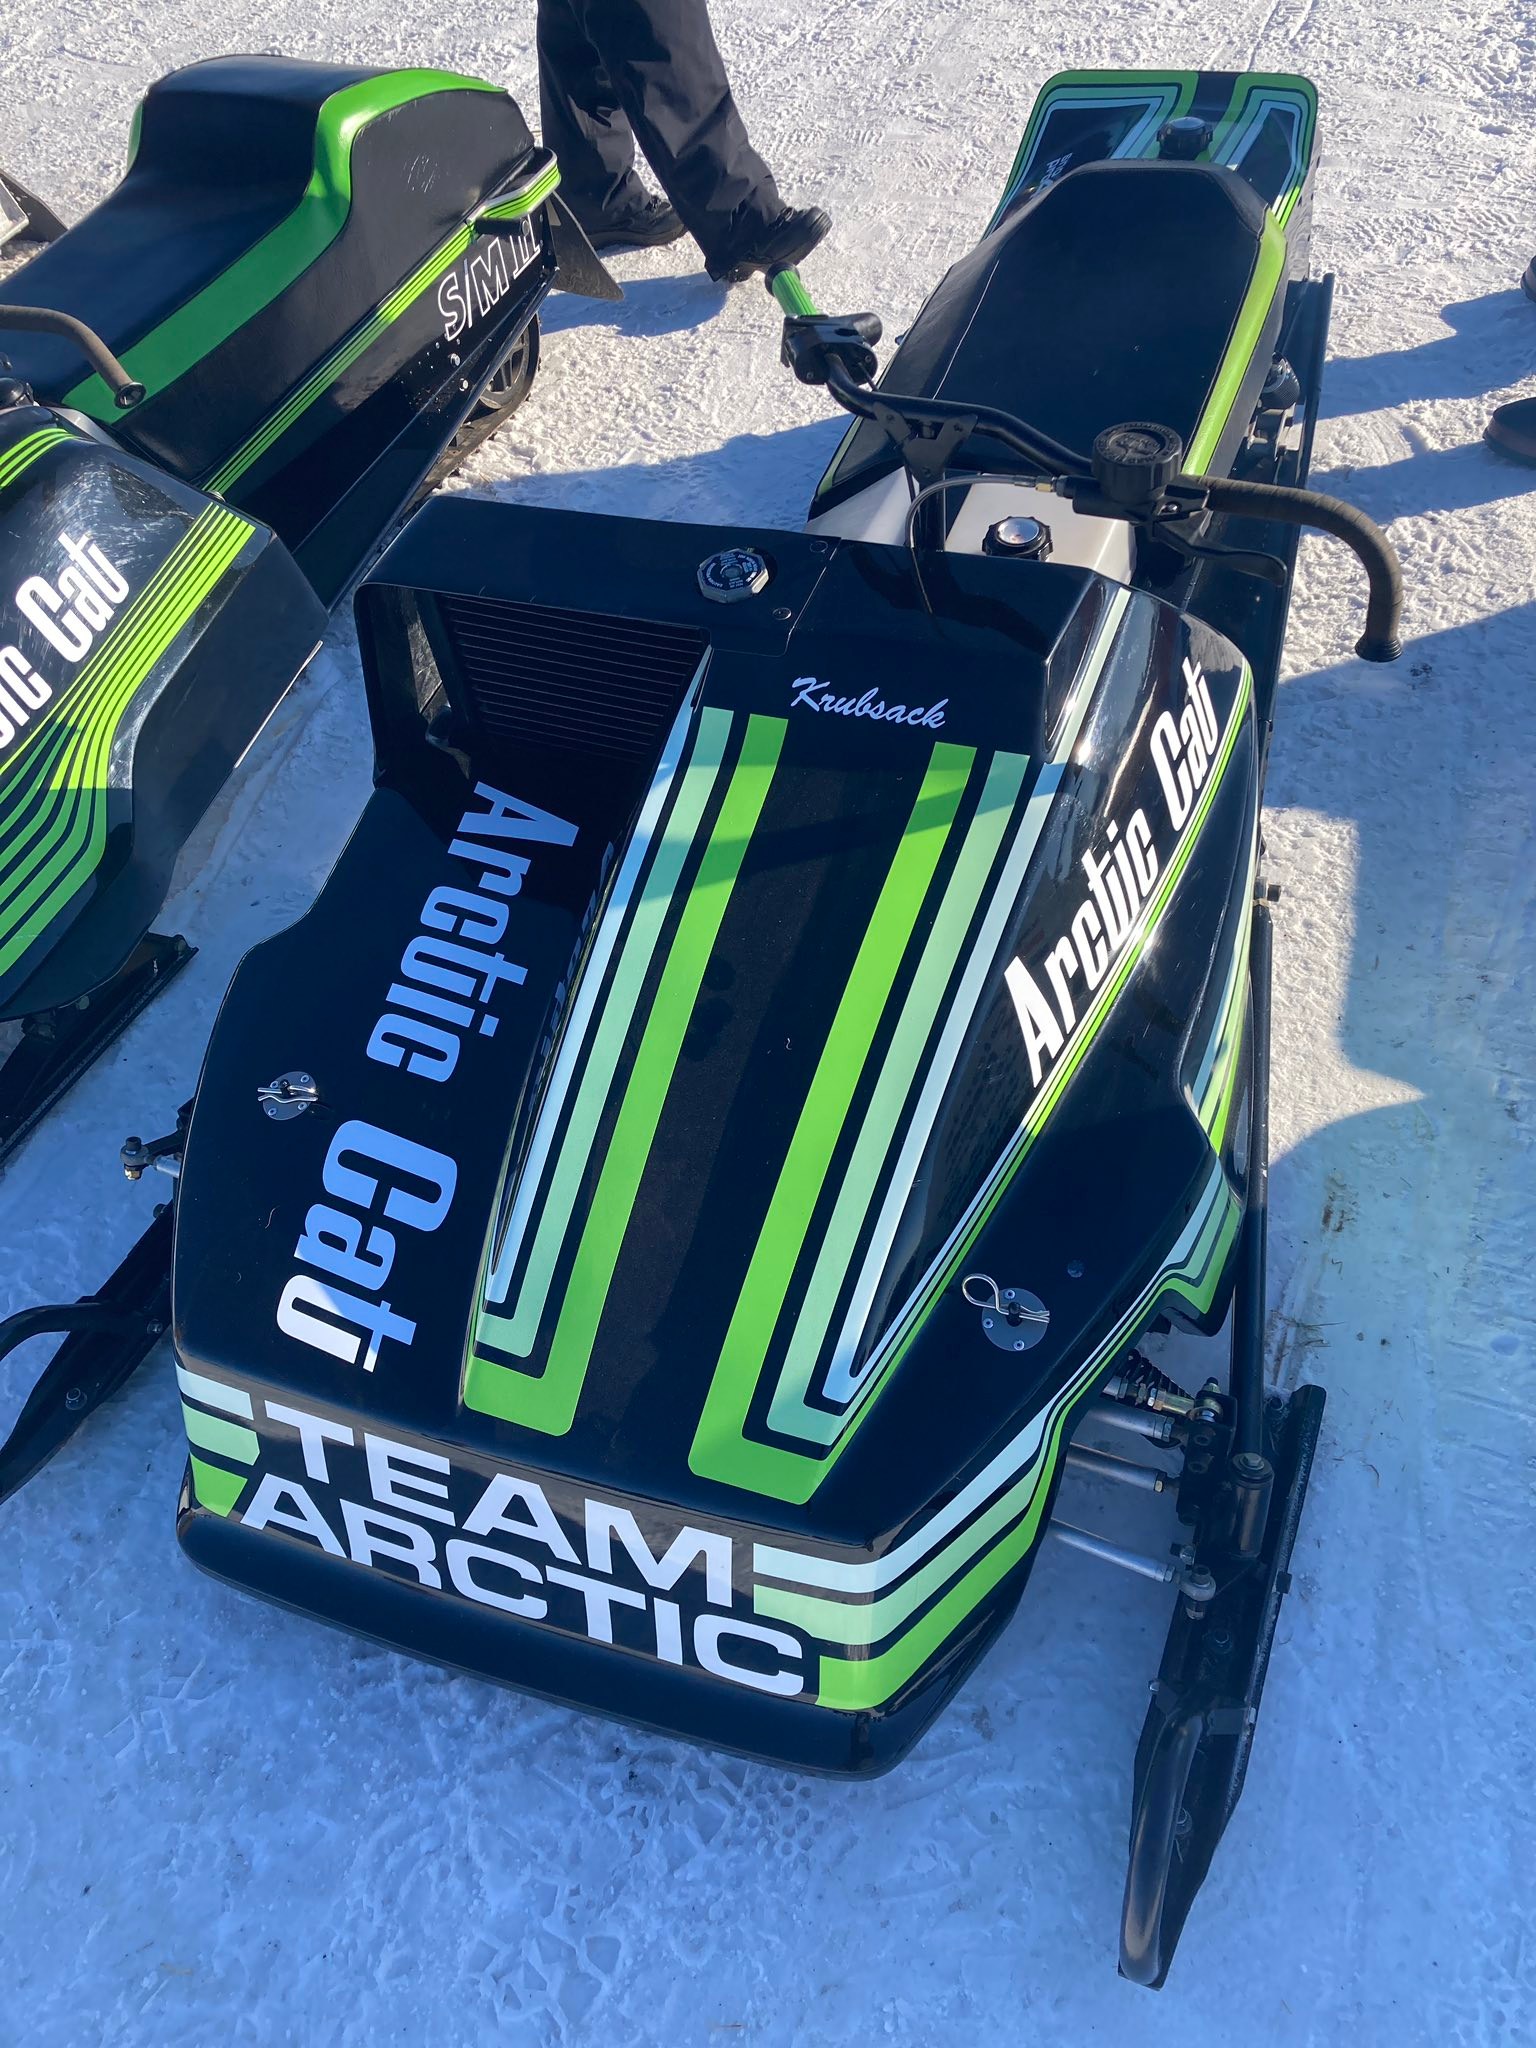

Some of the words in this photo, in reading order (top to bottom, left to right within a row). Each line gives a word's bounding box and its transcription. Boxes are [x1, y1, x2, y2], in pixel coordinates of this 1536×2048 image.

[15, 531, 130, 663] Cat
[790, 677, 949, 729] Krubsack
[366, 780, 580, 1083] Arctic
[1004, 809, 1160, 1088] Arctic
[1149, 656, 1219, 832] Cat
[276, 1119, 458, 1373] Cat
[240, 1472, 804, 1697] ARCTIC
[264, 1399, 733, 1608] TEAM
